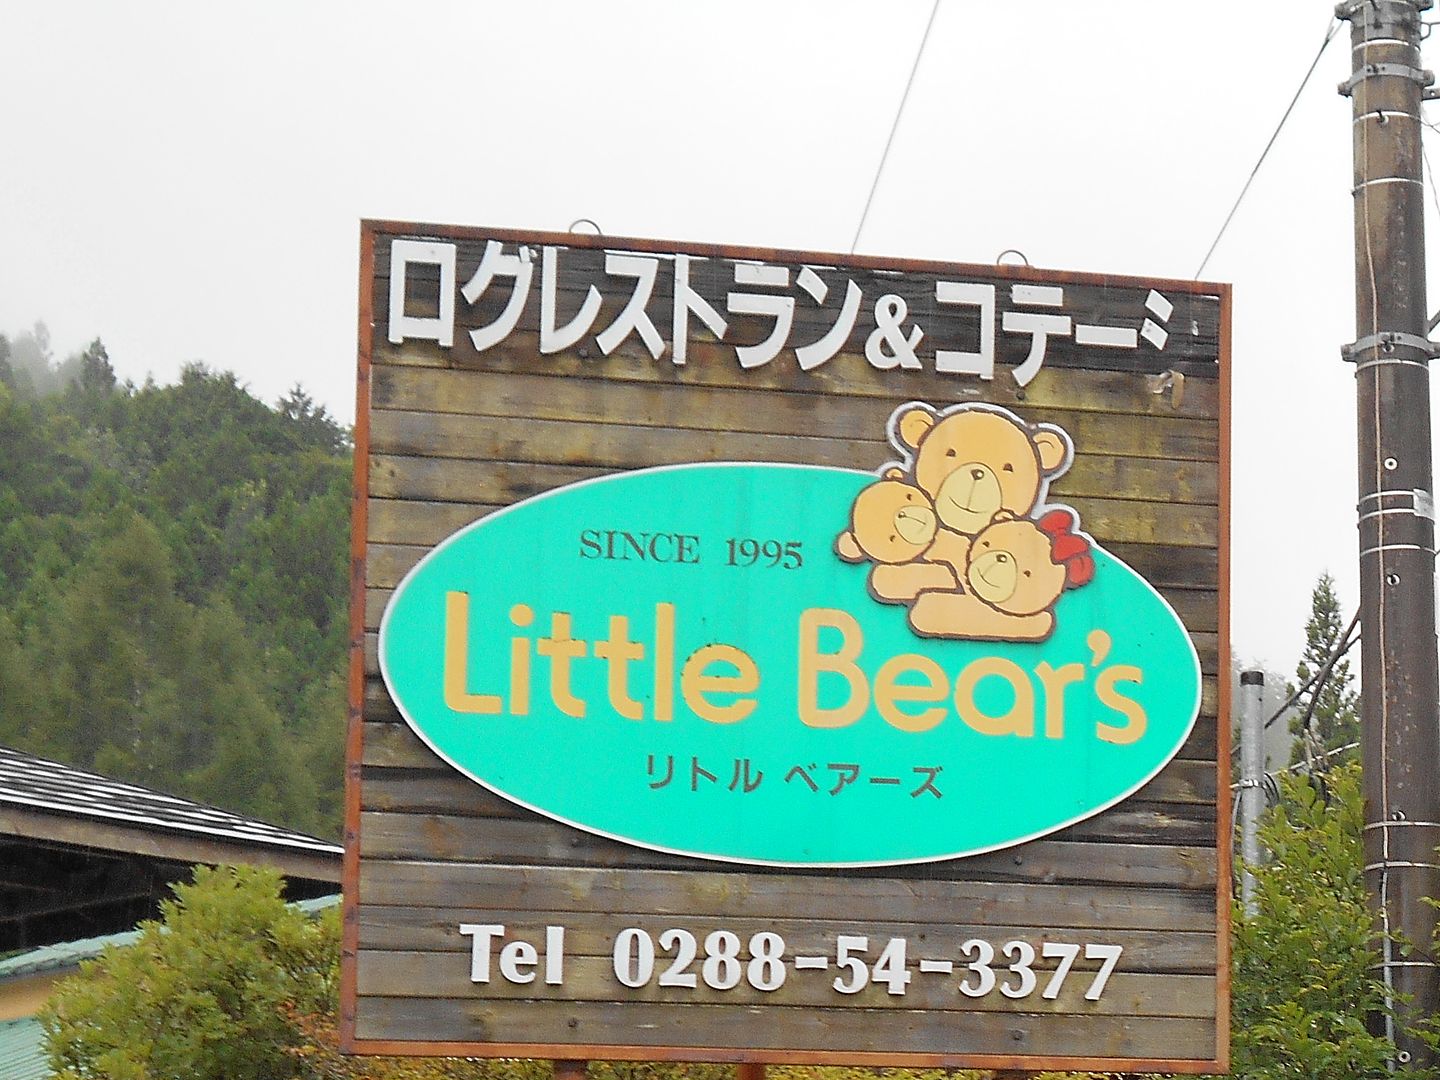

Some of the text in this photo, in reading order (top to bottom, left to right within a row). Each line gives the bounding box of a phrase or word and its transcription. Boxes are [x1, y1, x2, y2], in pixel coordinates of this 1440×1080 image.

[578, 529, 803, 570] SINCE 1995
[443, 592, 1148, 744] Little Bear's
[459, 923, 1124, 1001] Tel 0288-54-3377
